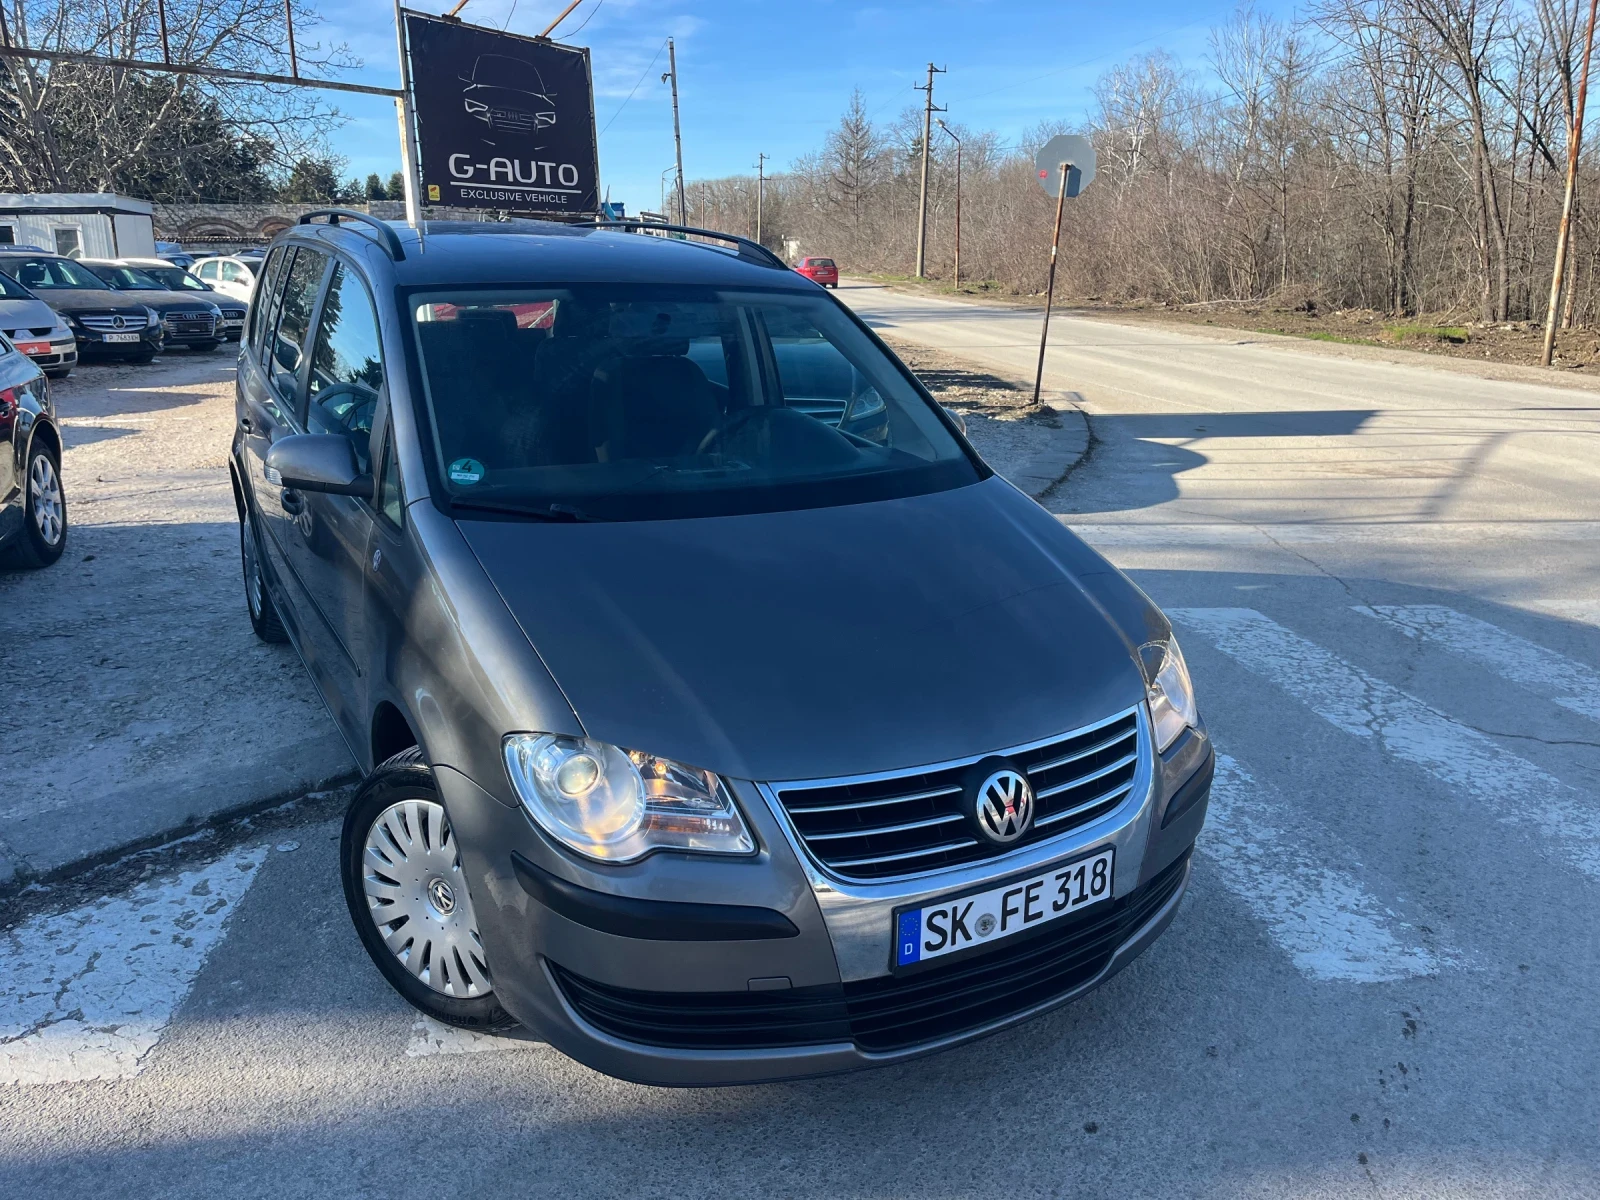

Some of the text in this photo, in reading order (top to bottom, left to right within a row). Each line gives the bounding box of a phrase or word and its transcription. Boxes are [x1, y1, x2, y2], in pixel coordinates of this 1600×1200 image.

[448, 153, 579, 187] G-AUTO
[460, 188, 568, 204] EXCLUSIVE VEHICLE
[461, 460, 473, 473] 4
[924, 857, 1108, 952] SK FE 318
[904, 943, 913, 955] D
